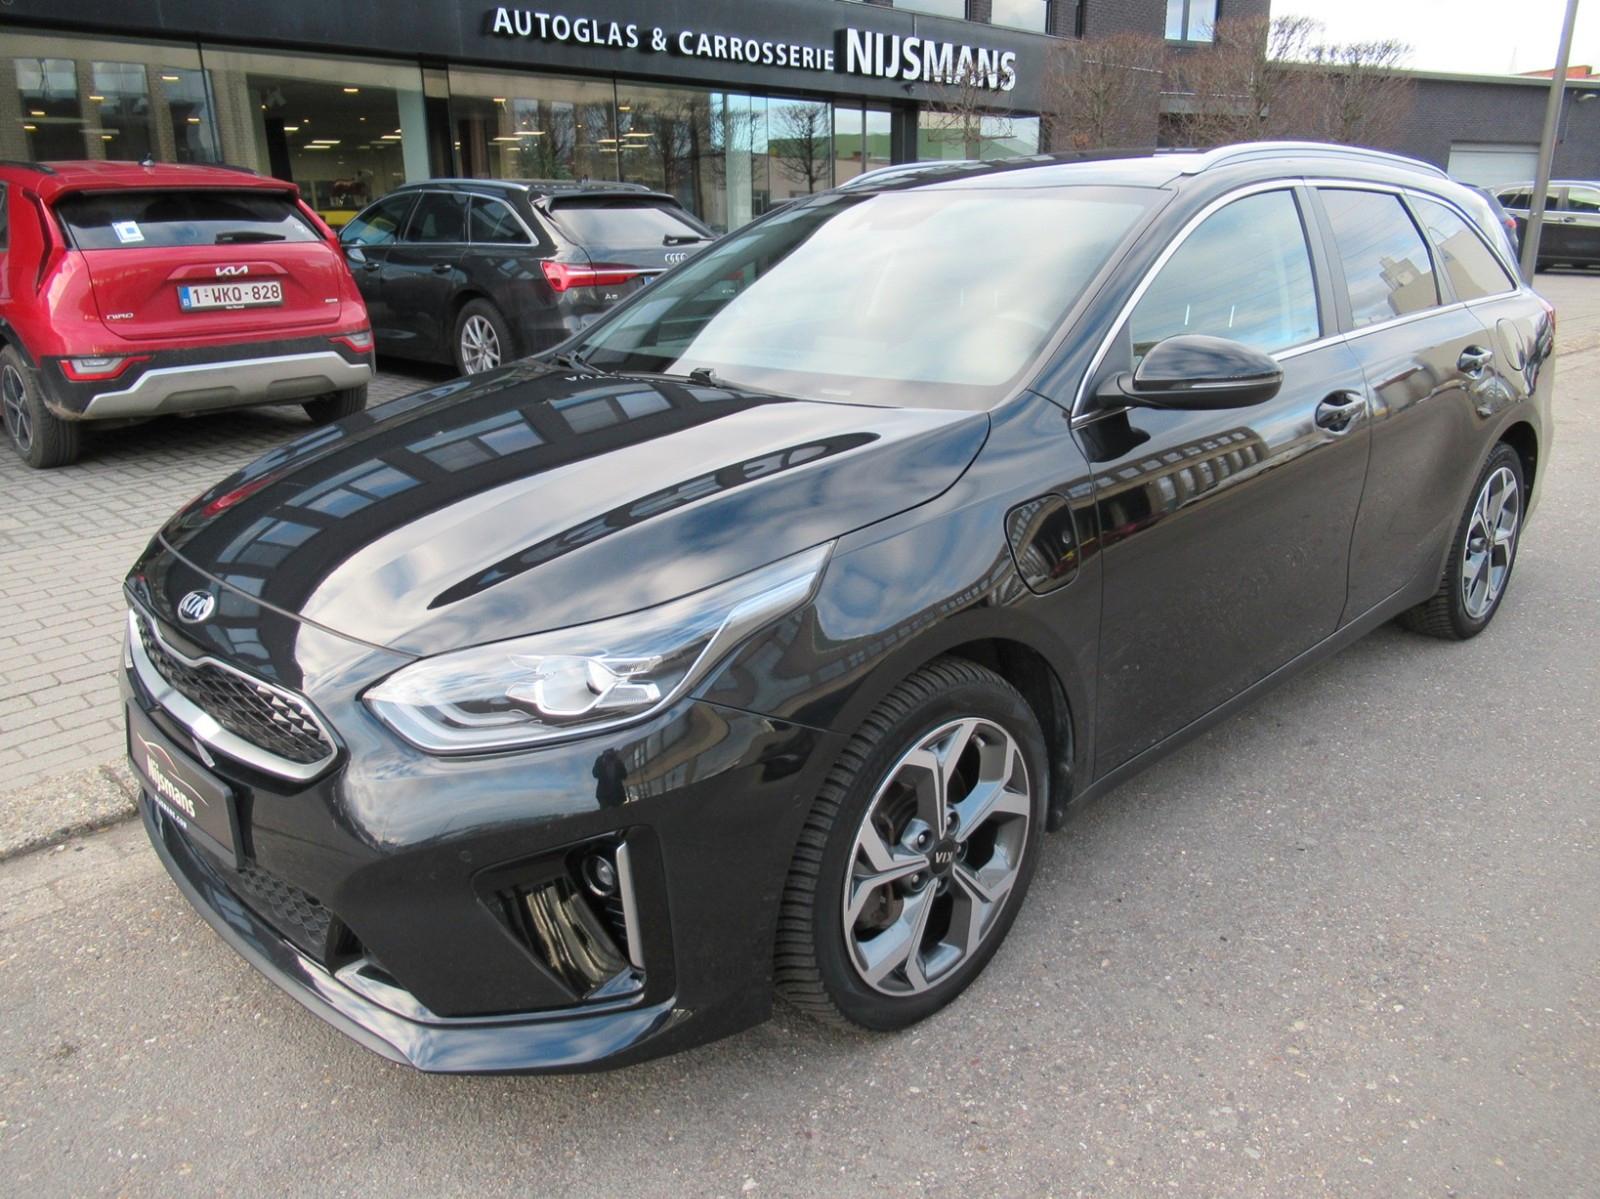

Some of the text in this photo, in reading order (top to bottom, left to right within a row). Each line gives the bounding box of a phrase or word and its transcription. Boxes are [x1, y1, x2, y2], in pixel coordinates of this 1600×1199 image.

[493, 7, 1016, 91] AUTOGLAS & CARROSSERIE NIJSMANS
[215, 265, 248, 276] KIA
